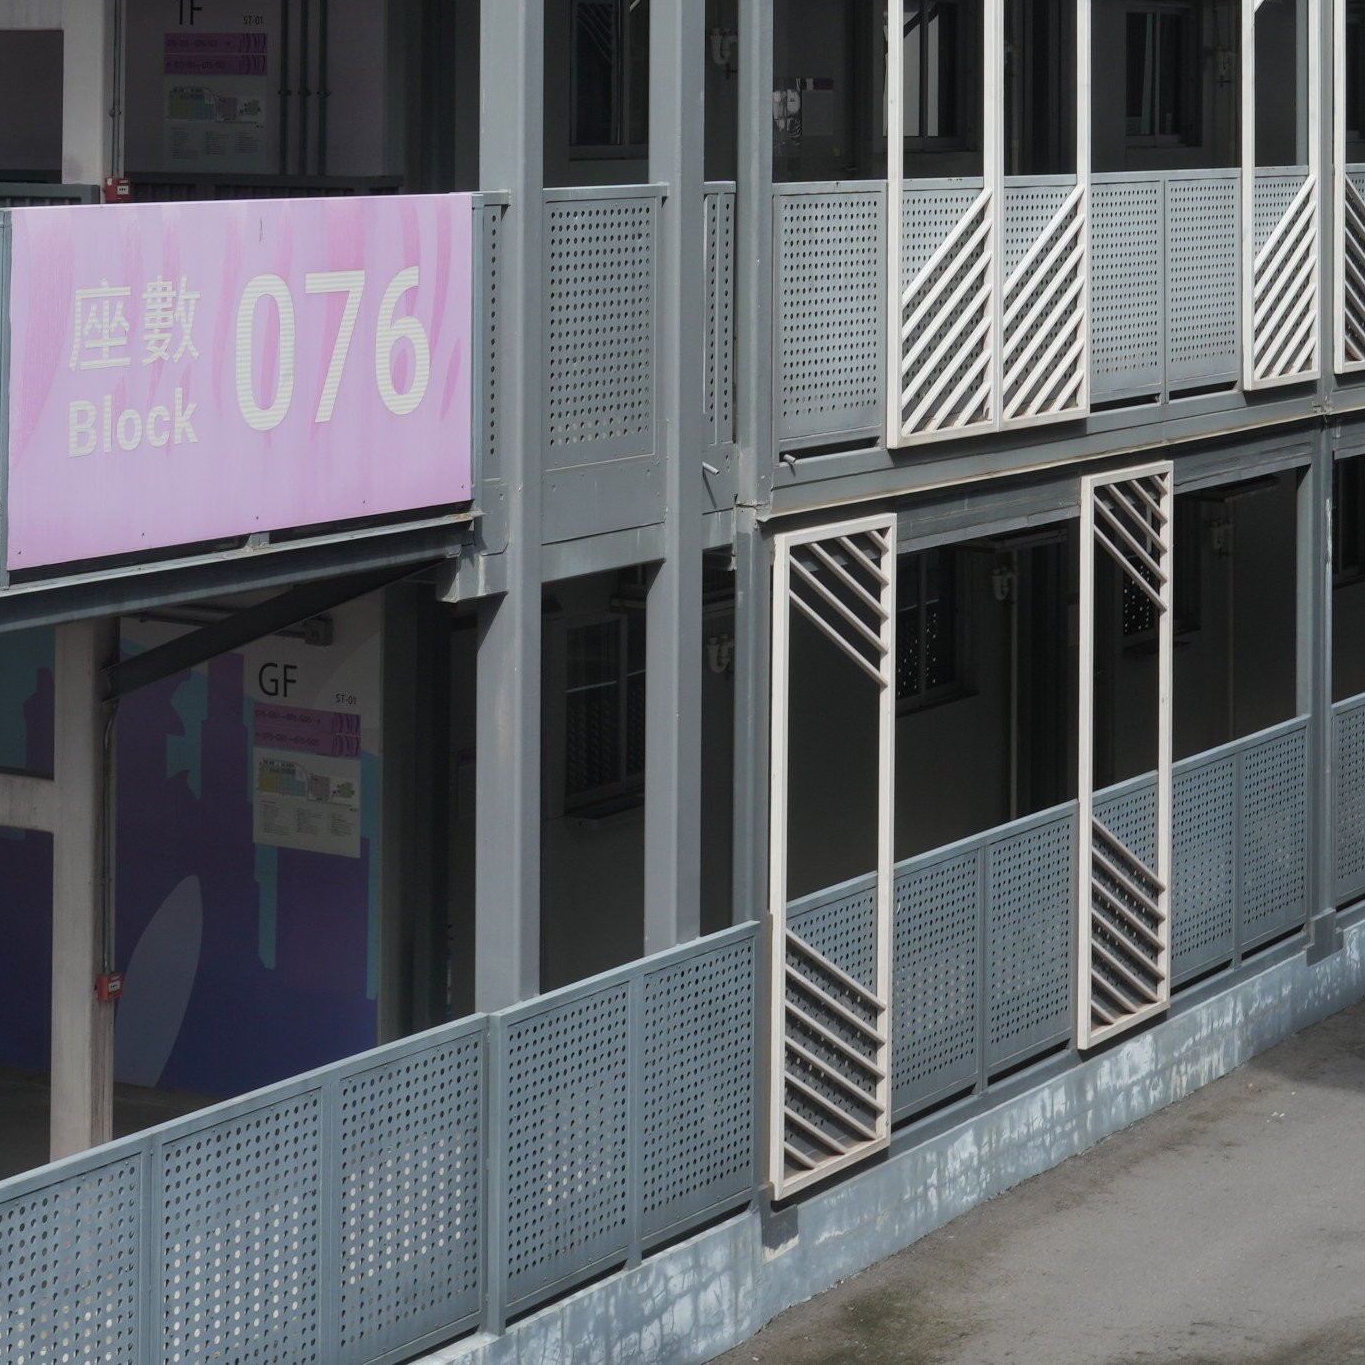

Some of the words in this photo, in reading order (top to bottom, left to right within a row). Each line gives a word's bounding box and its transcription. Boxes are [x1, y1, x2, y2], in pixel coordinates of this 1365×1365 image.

[243, 15, 264, 26] ST-01
[68, 275, 201, 371] 座數
[235, 266, 432, 432] 076
[68, 388, 198, 458] Block
[258, 662, 298, 698] GF
[335, 693, 357, 706] ST-01
